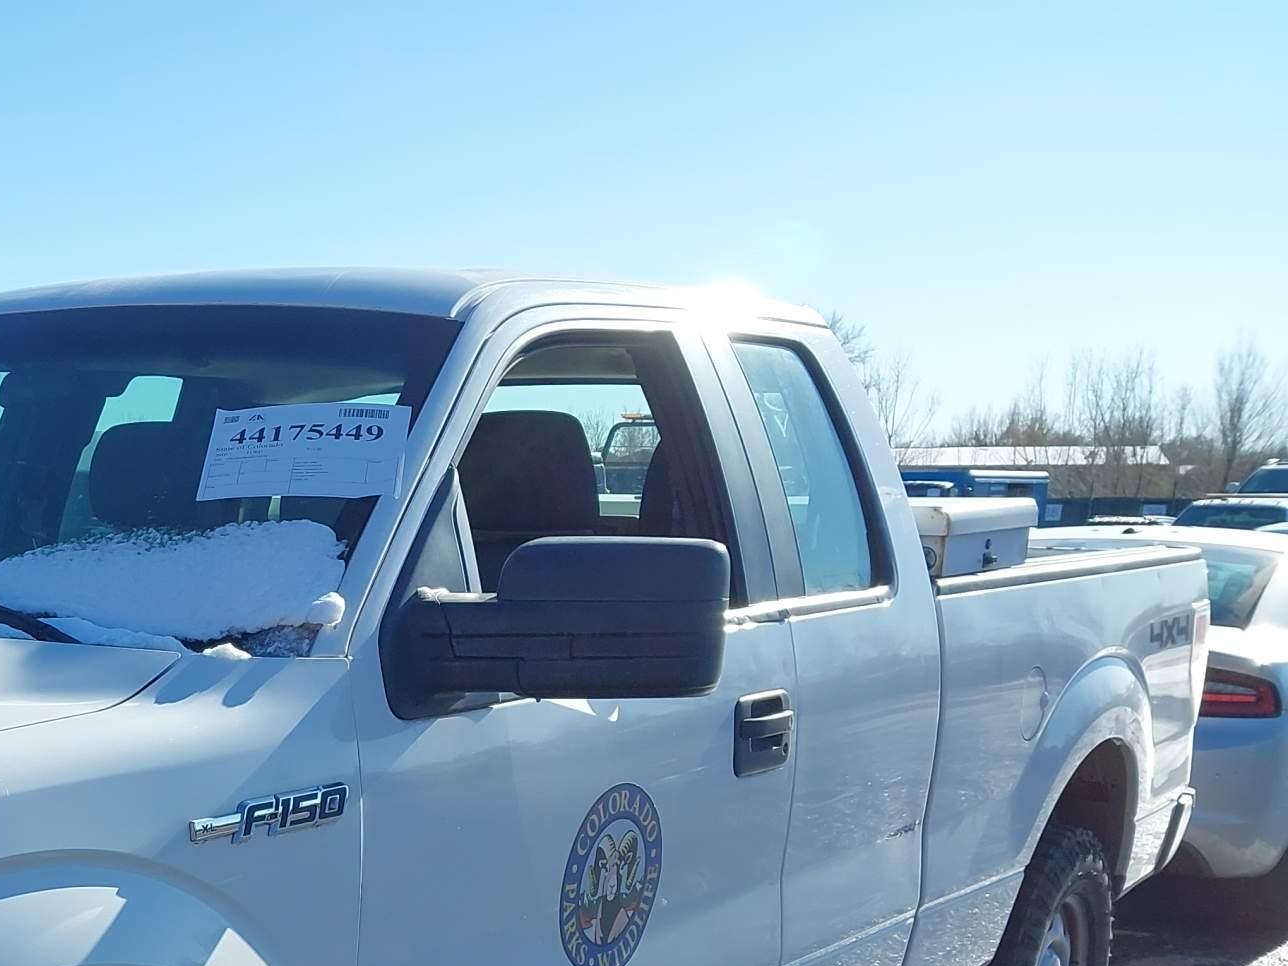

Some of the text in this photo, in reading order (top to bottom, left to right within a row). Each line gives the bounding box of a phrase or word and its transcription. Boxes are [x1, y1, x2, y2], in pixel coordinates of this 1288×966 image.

[229, 424, 384, 445] 44175449
[577, 790, 658, 856] COLORADO
[563, 883, 588, 965] PARKS
